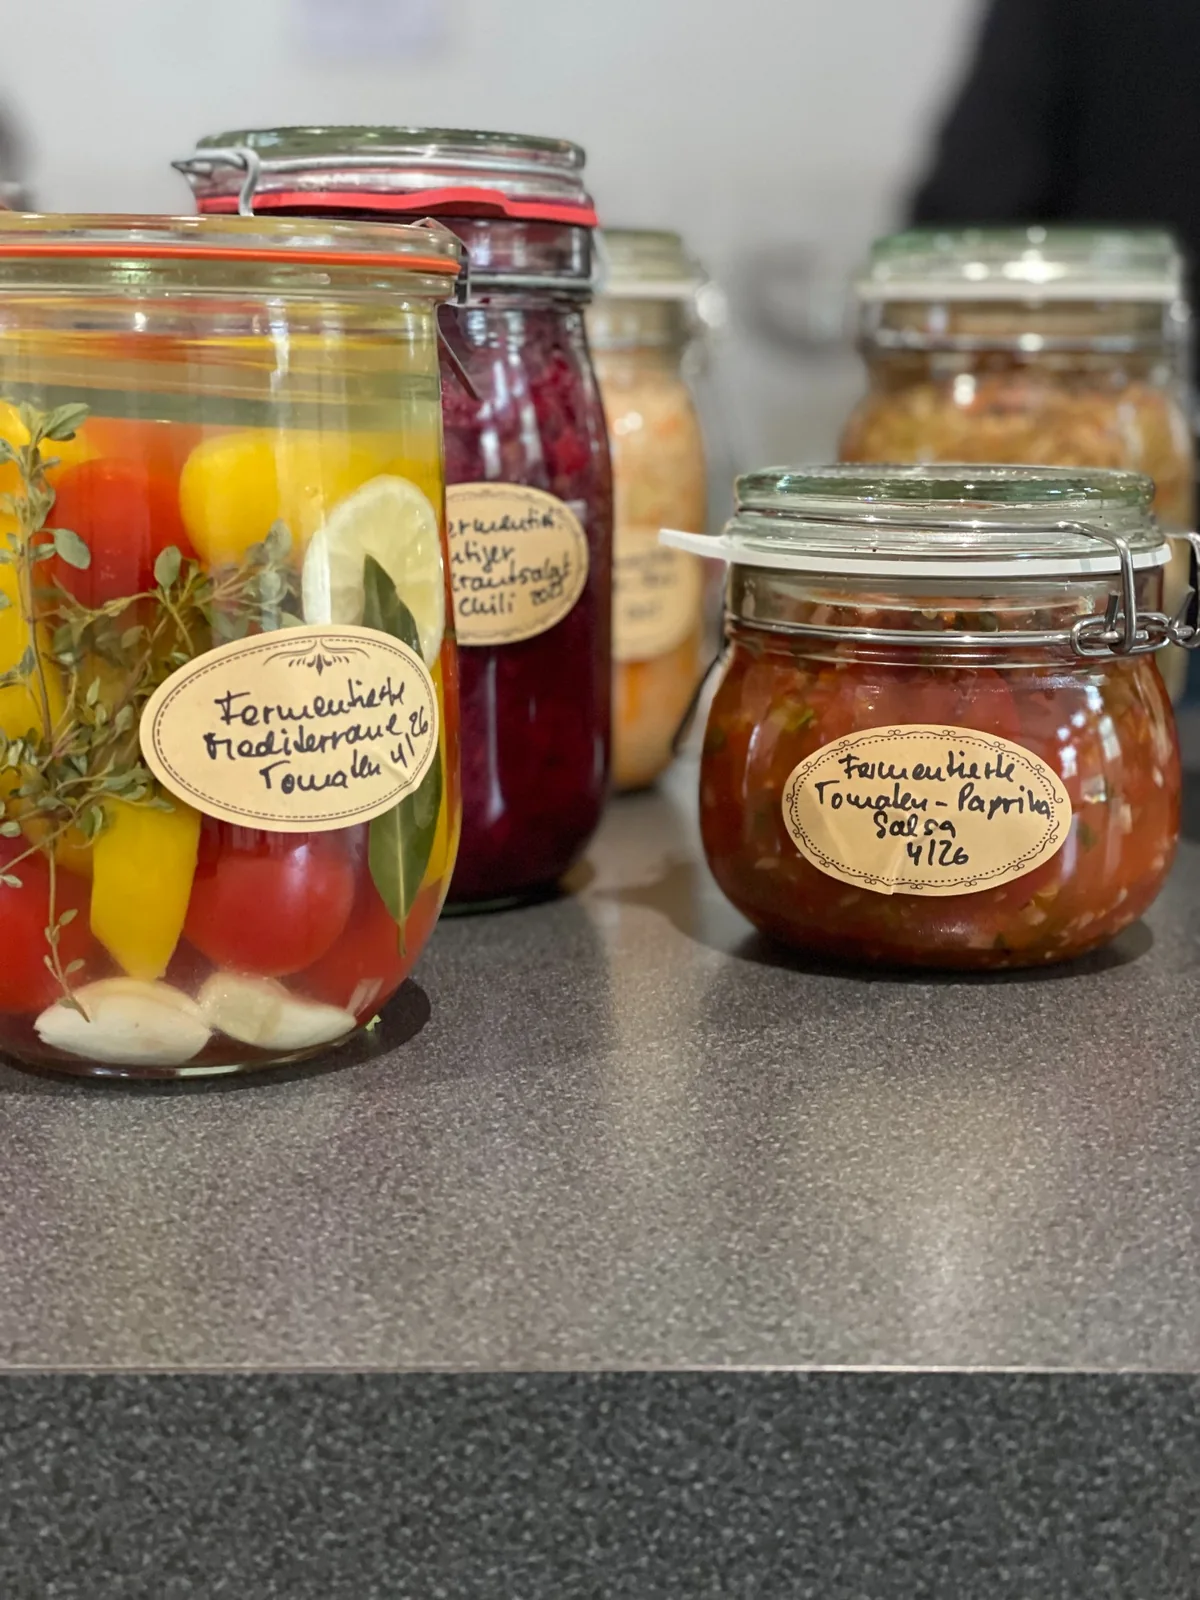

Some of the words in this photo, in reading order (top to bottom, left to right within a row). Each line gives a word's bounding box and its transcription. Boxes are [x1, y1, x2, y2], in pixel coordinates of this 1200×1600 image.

[459, 592, 517, 617] Chili
[215, 676, 405, 726] Fermentierte
[260, 748, 382, 795] Tomaten
[838, 750, 1016, 783] Fermentierte
[873, 810, 956, 839] Salsa
